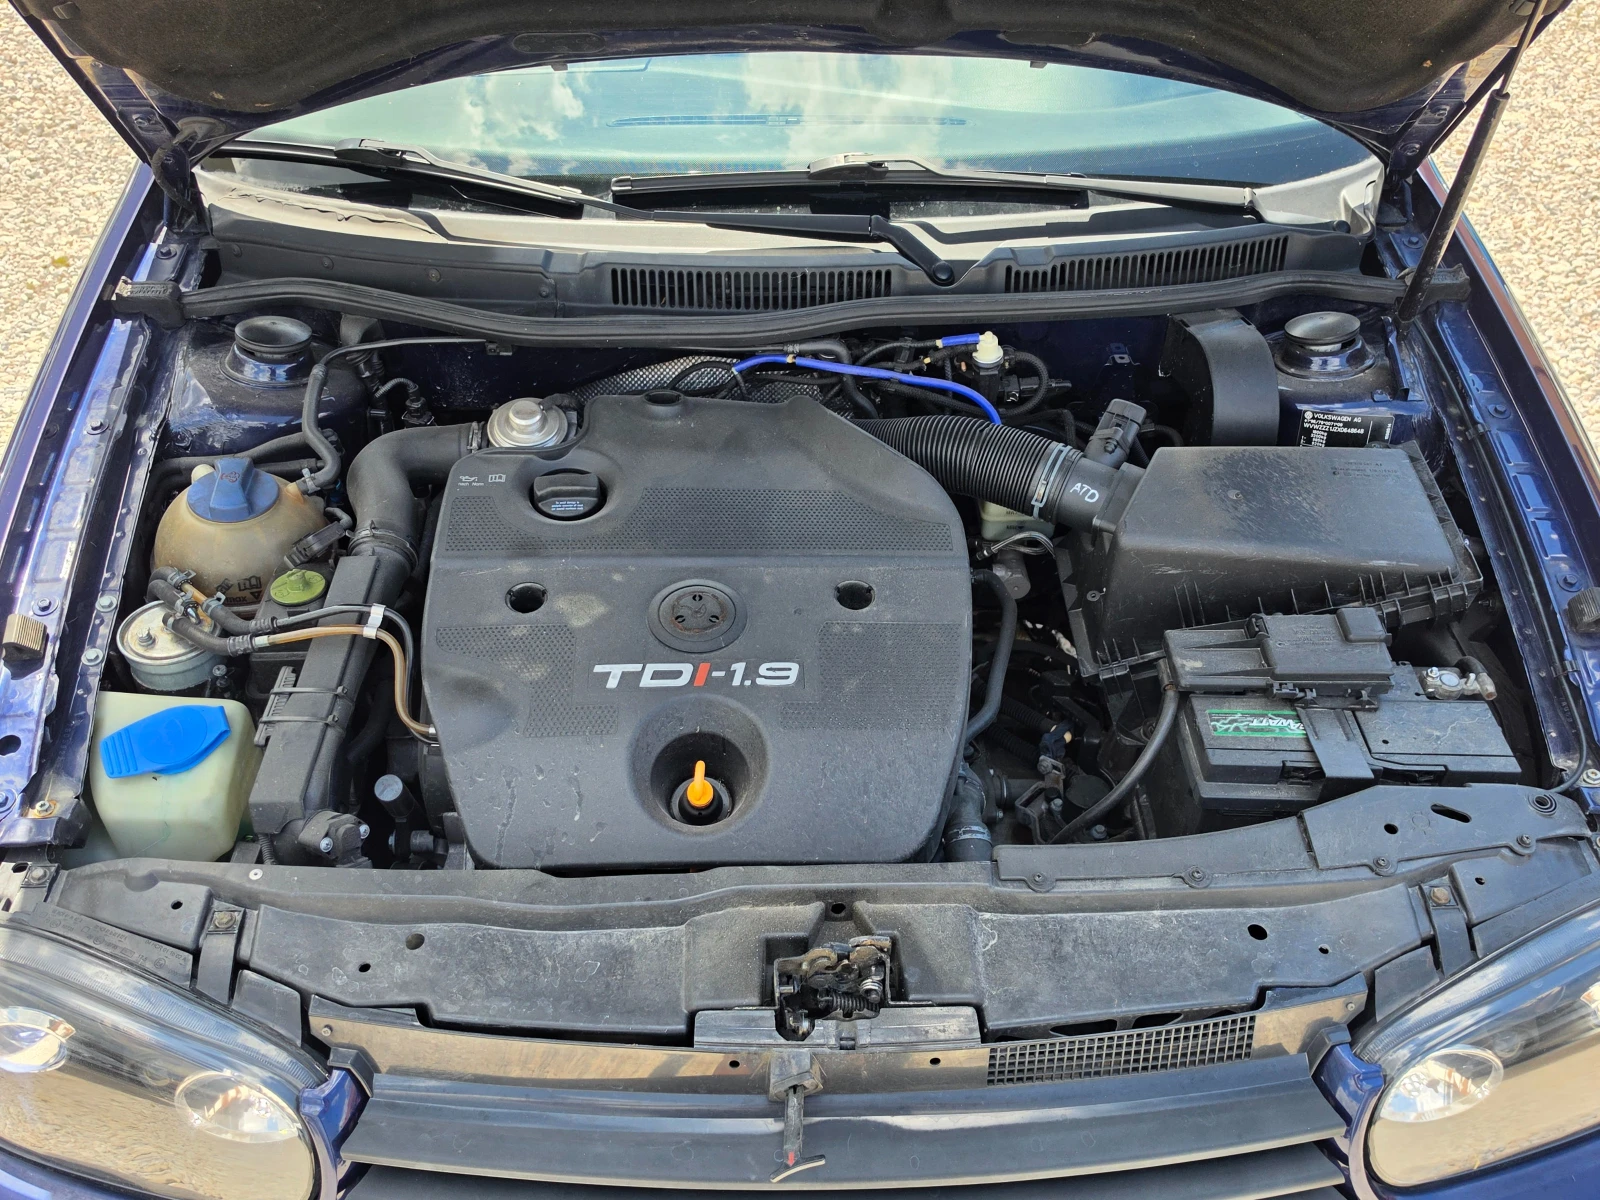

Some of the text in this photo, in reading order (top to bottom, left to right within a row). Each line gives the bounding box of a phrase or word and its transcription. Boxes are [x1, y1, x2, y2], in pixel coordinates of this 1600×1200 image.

[1314, 413, 1351, 422] VOLKSWAGEN
[1070, 482, 1100, 503] ATD
[593, 661, 800, 689] TDI-1.9
